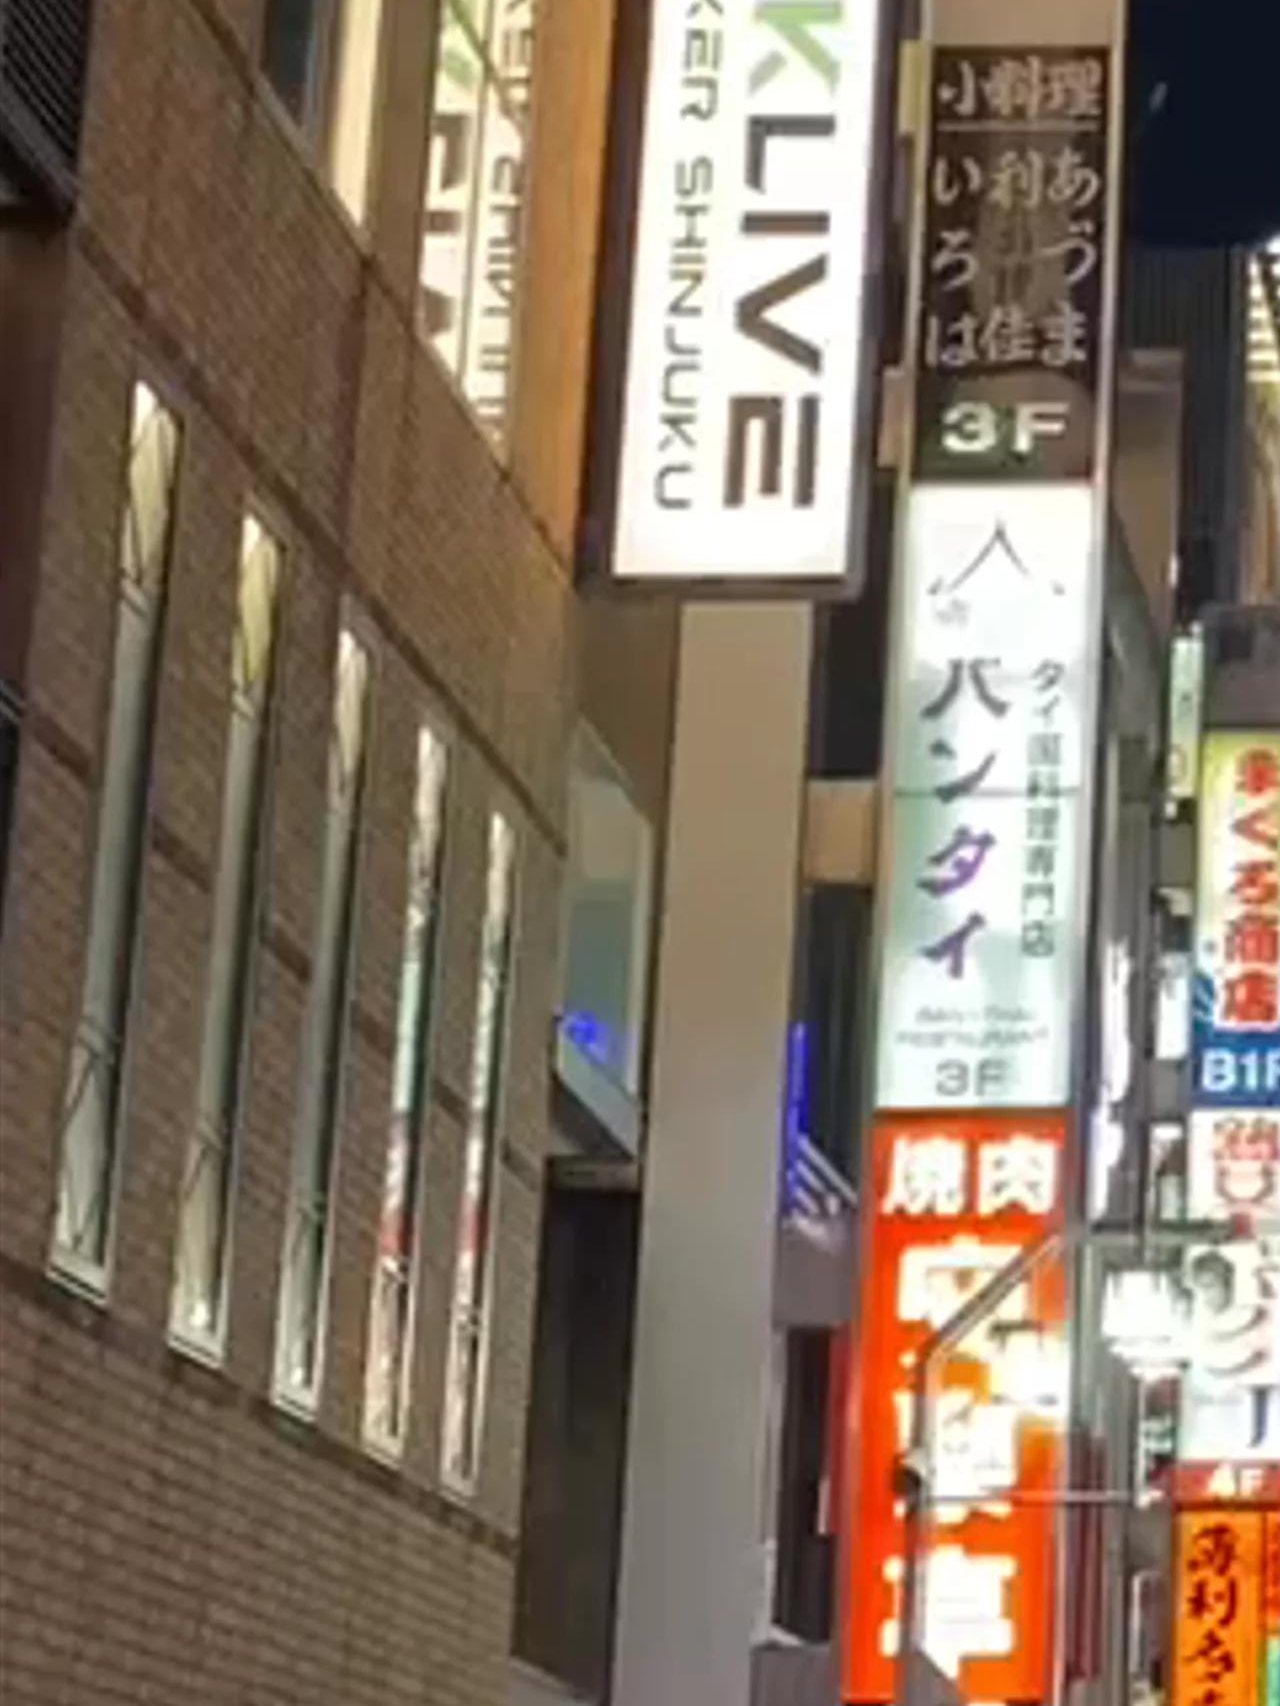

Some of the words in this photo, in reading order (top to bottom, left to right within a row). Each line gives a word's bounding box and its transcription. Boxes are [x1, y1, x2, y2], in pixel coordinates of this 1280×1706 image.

[937, 56, 1103, 117] 小料理
[654, 154, 712, 516] SHINJUKU
[940, 400, 1070, 456] 3F
